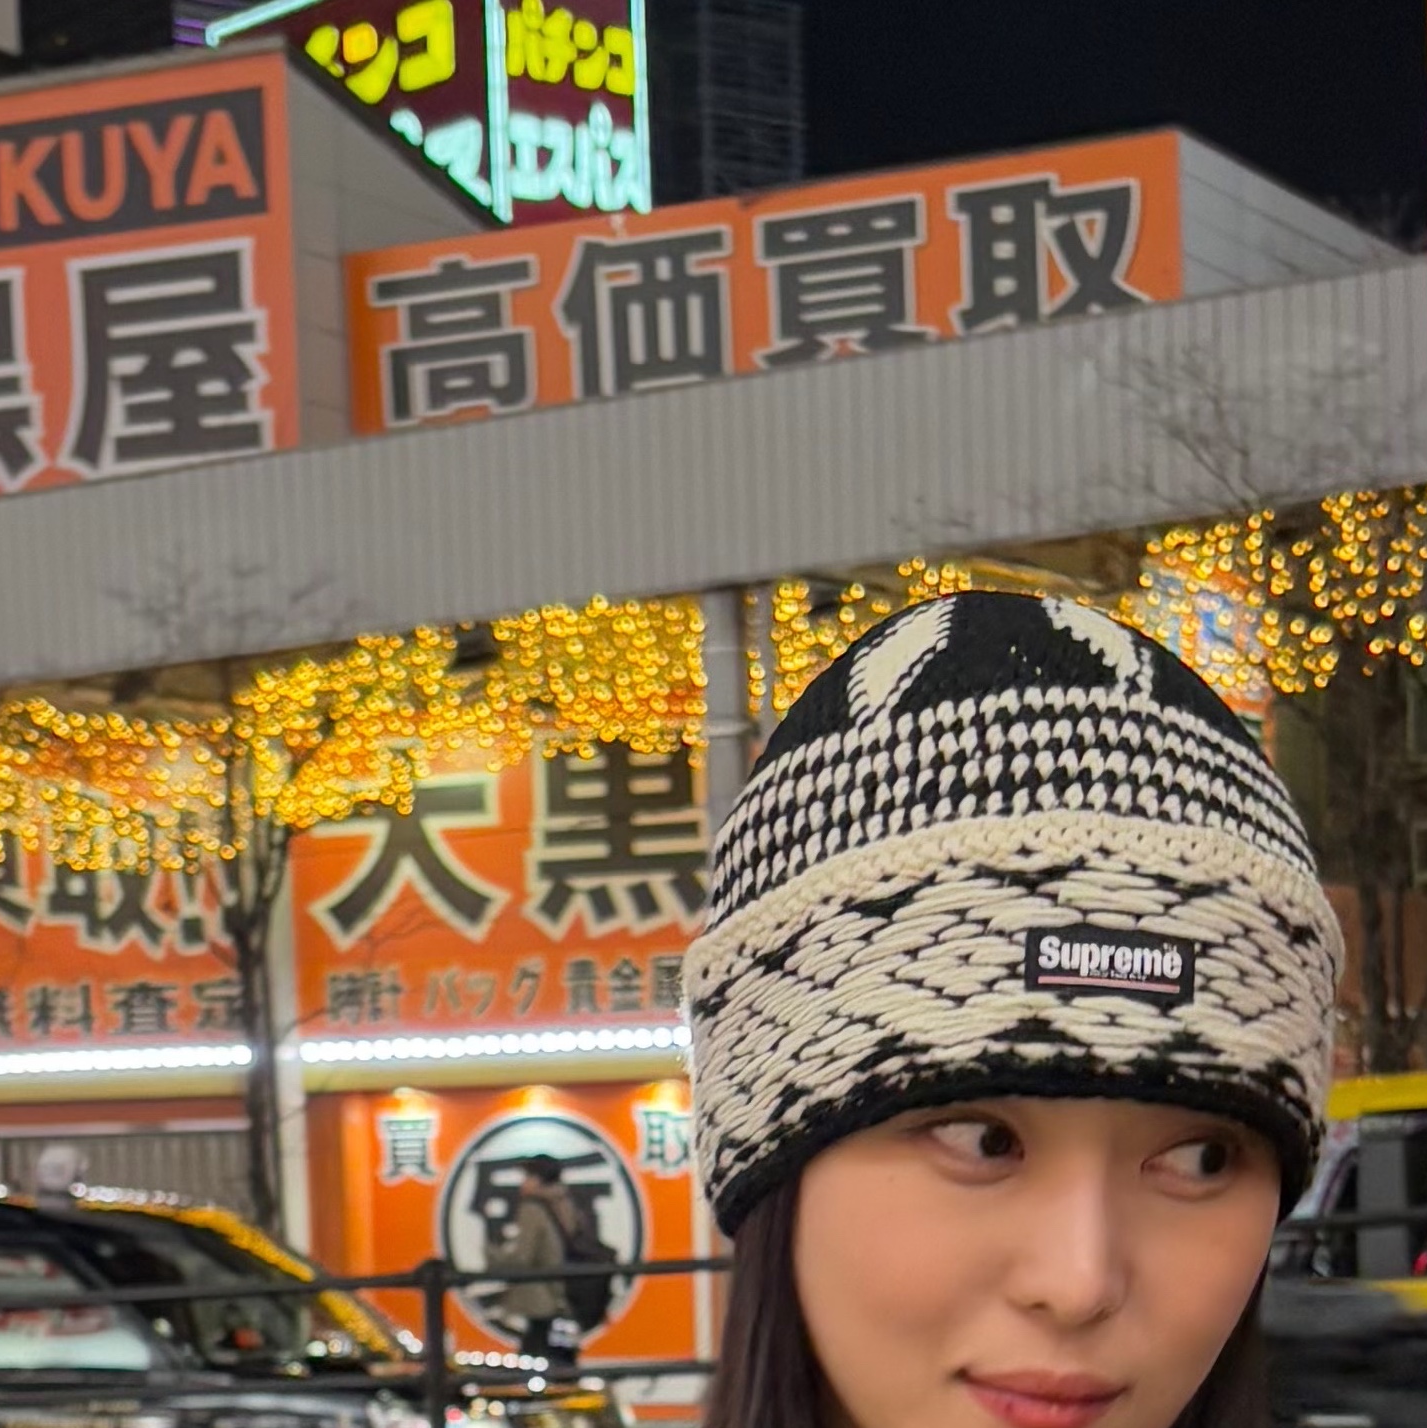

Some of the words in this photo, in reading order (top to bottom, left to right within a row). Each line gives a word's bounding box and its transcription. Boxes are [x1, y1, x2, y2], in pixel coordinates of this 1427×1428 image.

[368, 171, 1160, 427] 高価買取
[1038, 935, 1183, 979] Supreme
